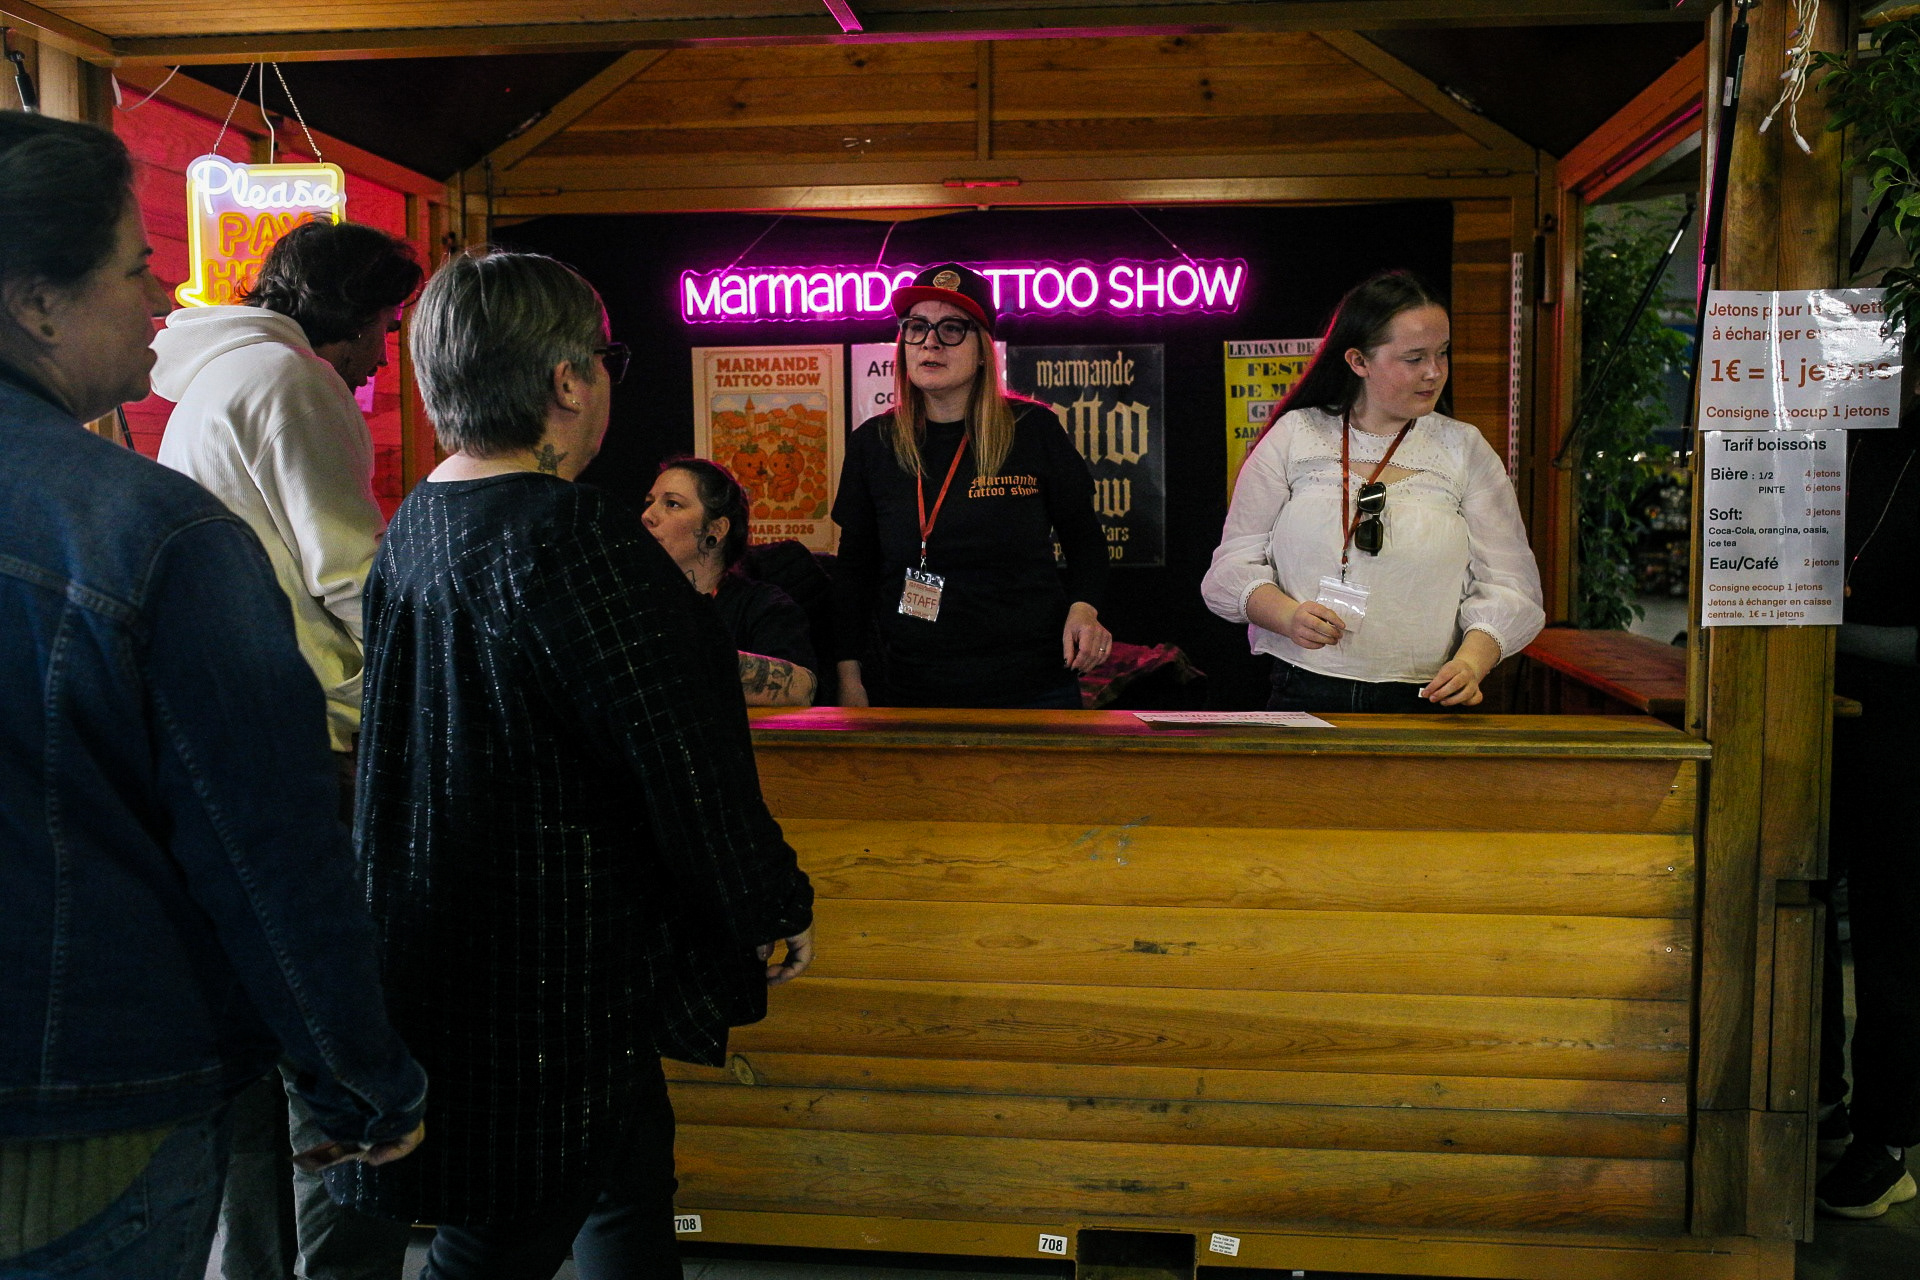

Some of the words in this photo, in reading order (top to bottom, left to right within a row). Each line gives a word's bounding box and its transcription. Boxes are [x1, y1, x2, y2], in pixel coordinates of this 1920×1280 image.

[191, 160, 340, 215] Please
[982, 266, 1099, 310] TTOO
[1108, 264, 1242, 309] SHOW
[1708, 302, 1759, 317] Jetons
[1712, 325, 1721, 340] à
[1229, 342, 1293, 356] LEVIGNAC
[1297, 341, 1315, 354] DE
[716, 356, 819, 373] MARMANDE
[1036, 350, 1135, 388] marmande
[1247, 361, 1308, 377] FEST
[1710, 359, 1741, 382] 1€
[1748, 367, 1765, 379] =
[715, 374, 773, 388] TATTOO
[776, 373, 821, 387] SHOW
[1230, 384, 1262, 398] DE
[1706, 405, 1770, 420] Consigne
[1773, 407, 1828, 420] ocup
[1832, 405, 1841, 417] 1
[1843, 404, 1890, 419] jetons
[1050, 391, 1150, 465] ttoo
[1722, 438, 1754, 451] Tarif
[1757, 438, 1827, 451] boissons
[1711, 467, 1749, 480] Bière
[1758, 471, 1774, 480] 1/2
[1804, 470, 1811, 478] 4
[1812, 470, 1841, 479] jetons
[968, 486, 1005, 499] tattoo
[1758, 486, 1786, 494] PINTE
[1805, 484, 1811, 492] 6
[1812, 484, 1841, 493] jetons
[1709, 507, 1742, 521] Soft:
[1805, 508, 1811, 516] 3
[1812, 508, 1841, 517] jetons
[784, 523, 815, 535] 2026
[1101, 524, 1129, 542] ars
[1708, 526, 1757, 536] Coca-Cola,
[1758, 526, 1801, 536] orangina,
[1802, 526, 1829, 535] oasis,
[1708, 539, 1722, 547] ice
[1723, 539, 1737, 547] tea
[1709, 556, 1779, 571] Eau/Café
[1804, 558, 1810, 567] 2
[1811, 558, 1840, 568] jetons
[1709, 583, 1750, 593] Consigne
[1751, 584, 1785, 594] ecocup
[1787, 583, 1792, 591] 1
[1794, 583, 1823, 592] jetons
[905, 591, 937, 610] STAFF
[1708, 598, 1737, 606] Jetons
[1738, 597, 1744, 606] à
[1746, 597, 1787, 608] échanger
[1803, 597, 1832, 606] caisse
[1707, 610, 1745, 619] centrale.
[1748, 610, 1759, 618] 1€
[1769, 610, 1774, 618] 1
[1776, 610, 1805, 620] jetons
[675, 1218, 697, 1231] 708
[1041, 1237, 1063, 1252] 708
